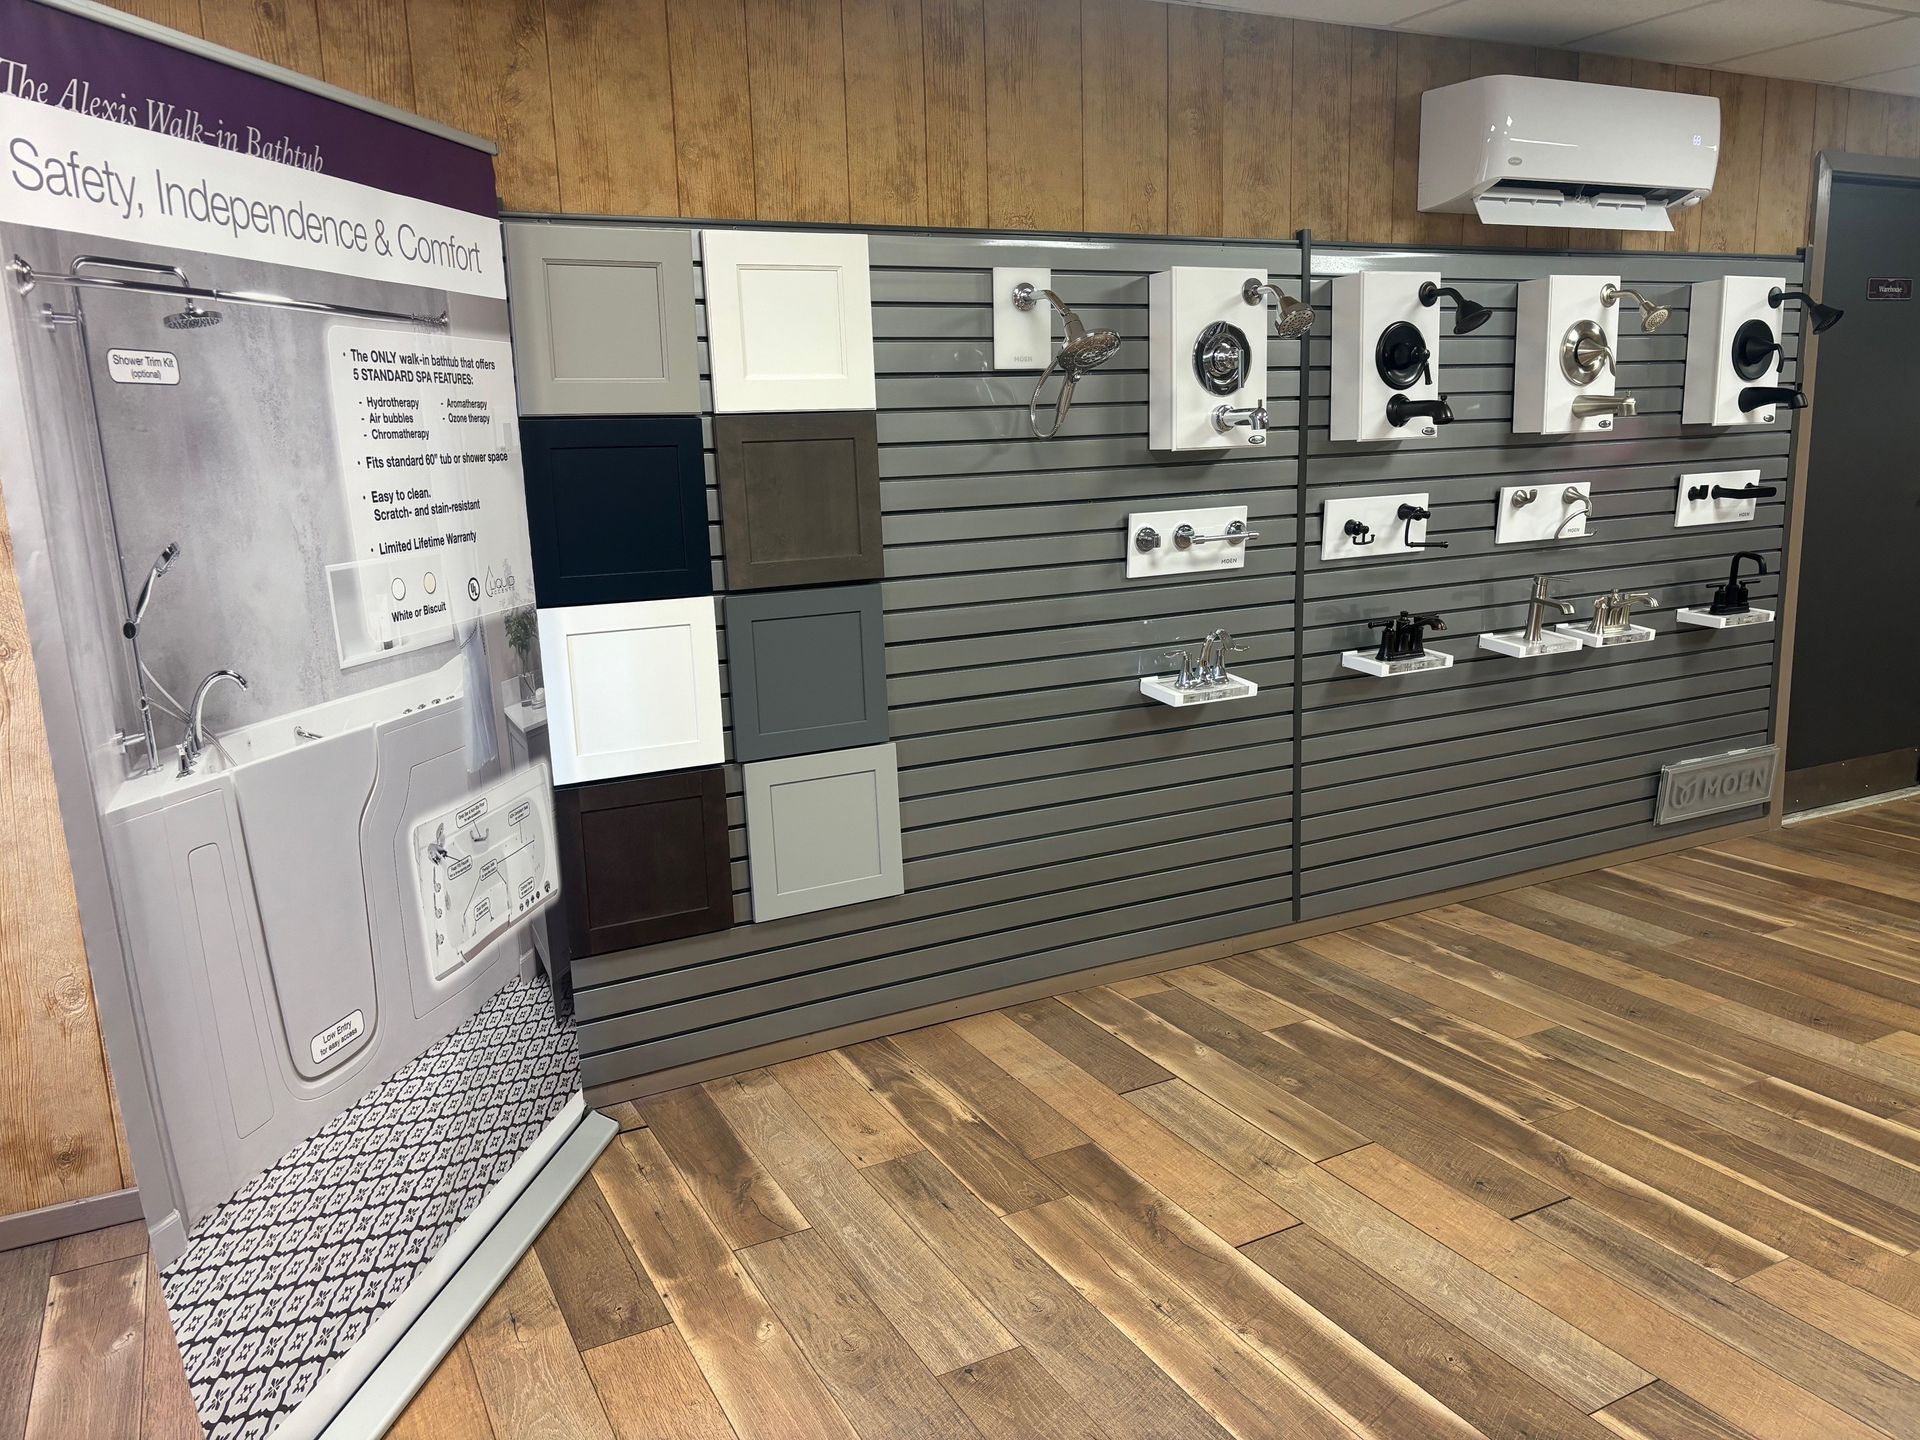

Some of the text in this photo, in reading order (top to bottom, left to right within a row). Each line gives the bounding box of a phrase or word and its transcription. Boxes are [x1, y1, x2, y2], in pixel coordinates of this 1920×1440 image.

[0, 57, 323, 172] The Alexis Walk-in Bathtub
[9, 137, 483, 274] Safety, Independence & Comfort
[112, 354, 174, 368] Shower Trim Kit
[350, 349, 495, 370] The ONLY walk-in bathtub that offers
[131, 369, 161, 380] (optional)
[353, 368, 474, 385] 5 STANDARD SPA FEATURES:
[367, 396, 420, 410] Hydrotherapy
[447, 398, 488, 411] Aromatherapy
[369, 413, 414, 424] Air bubbles
[448, 413, 490, 425] Ozone therapy
[371, 428, 430, 441] Chromatherapy
[366, 456, 384, 469] Fits
[386, 454, 425, 468] standard
[440, 453, 452, 465] tub
[453, 454, 461, 464] or
[462, 452, 486, 464] shower
[488, 452, 509, 464] space
[371, 487, 431, 505] Easy to clean.
[374, 499, 480, 521] Scratch- and stain-resistant
[378, 531, 477, 555] Limited Lifetime Warranty
[1221, 557, 1237, 565] MOEN
[392, 602, 446, 623] White or Biscuit
[322, 1021, 352, 1044] Low Entry
[329, 1040, 340, 1051] easy
